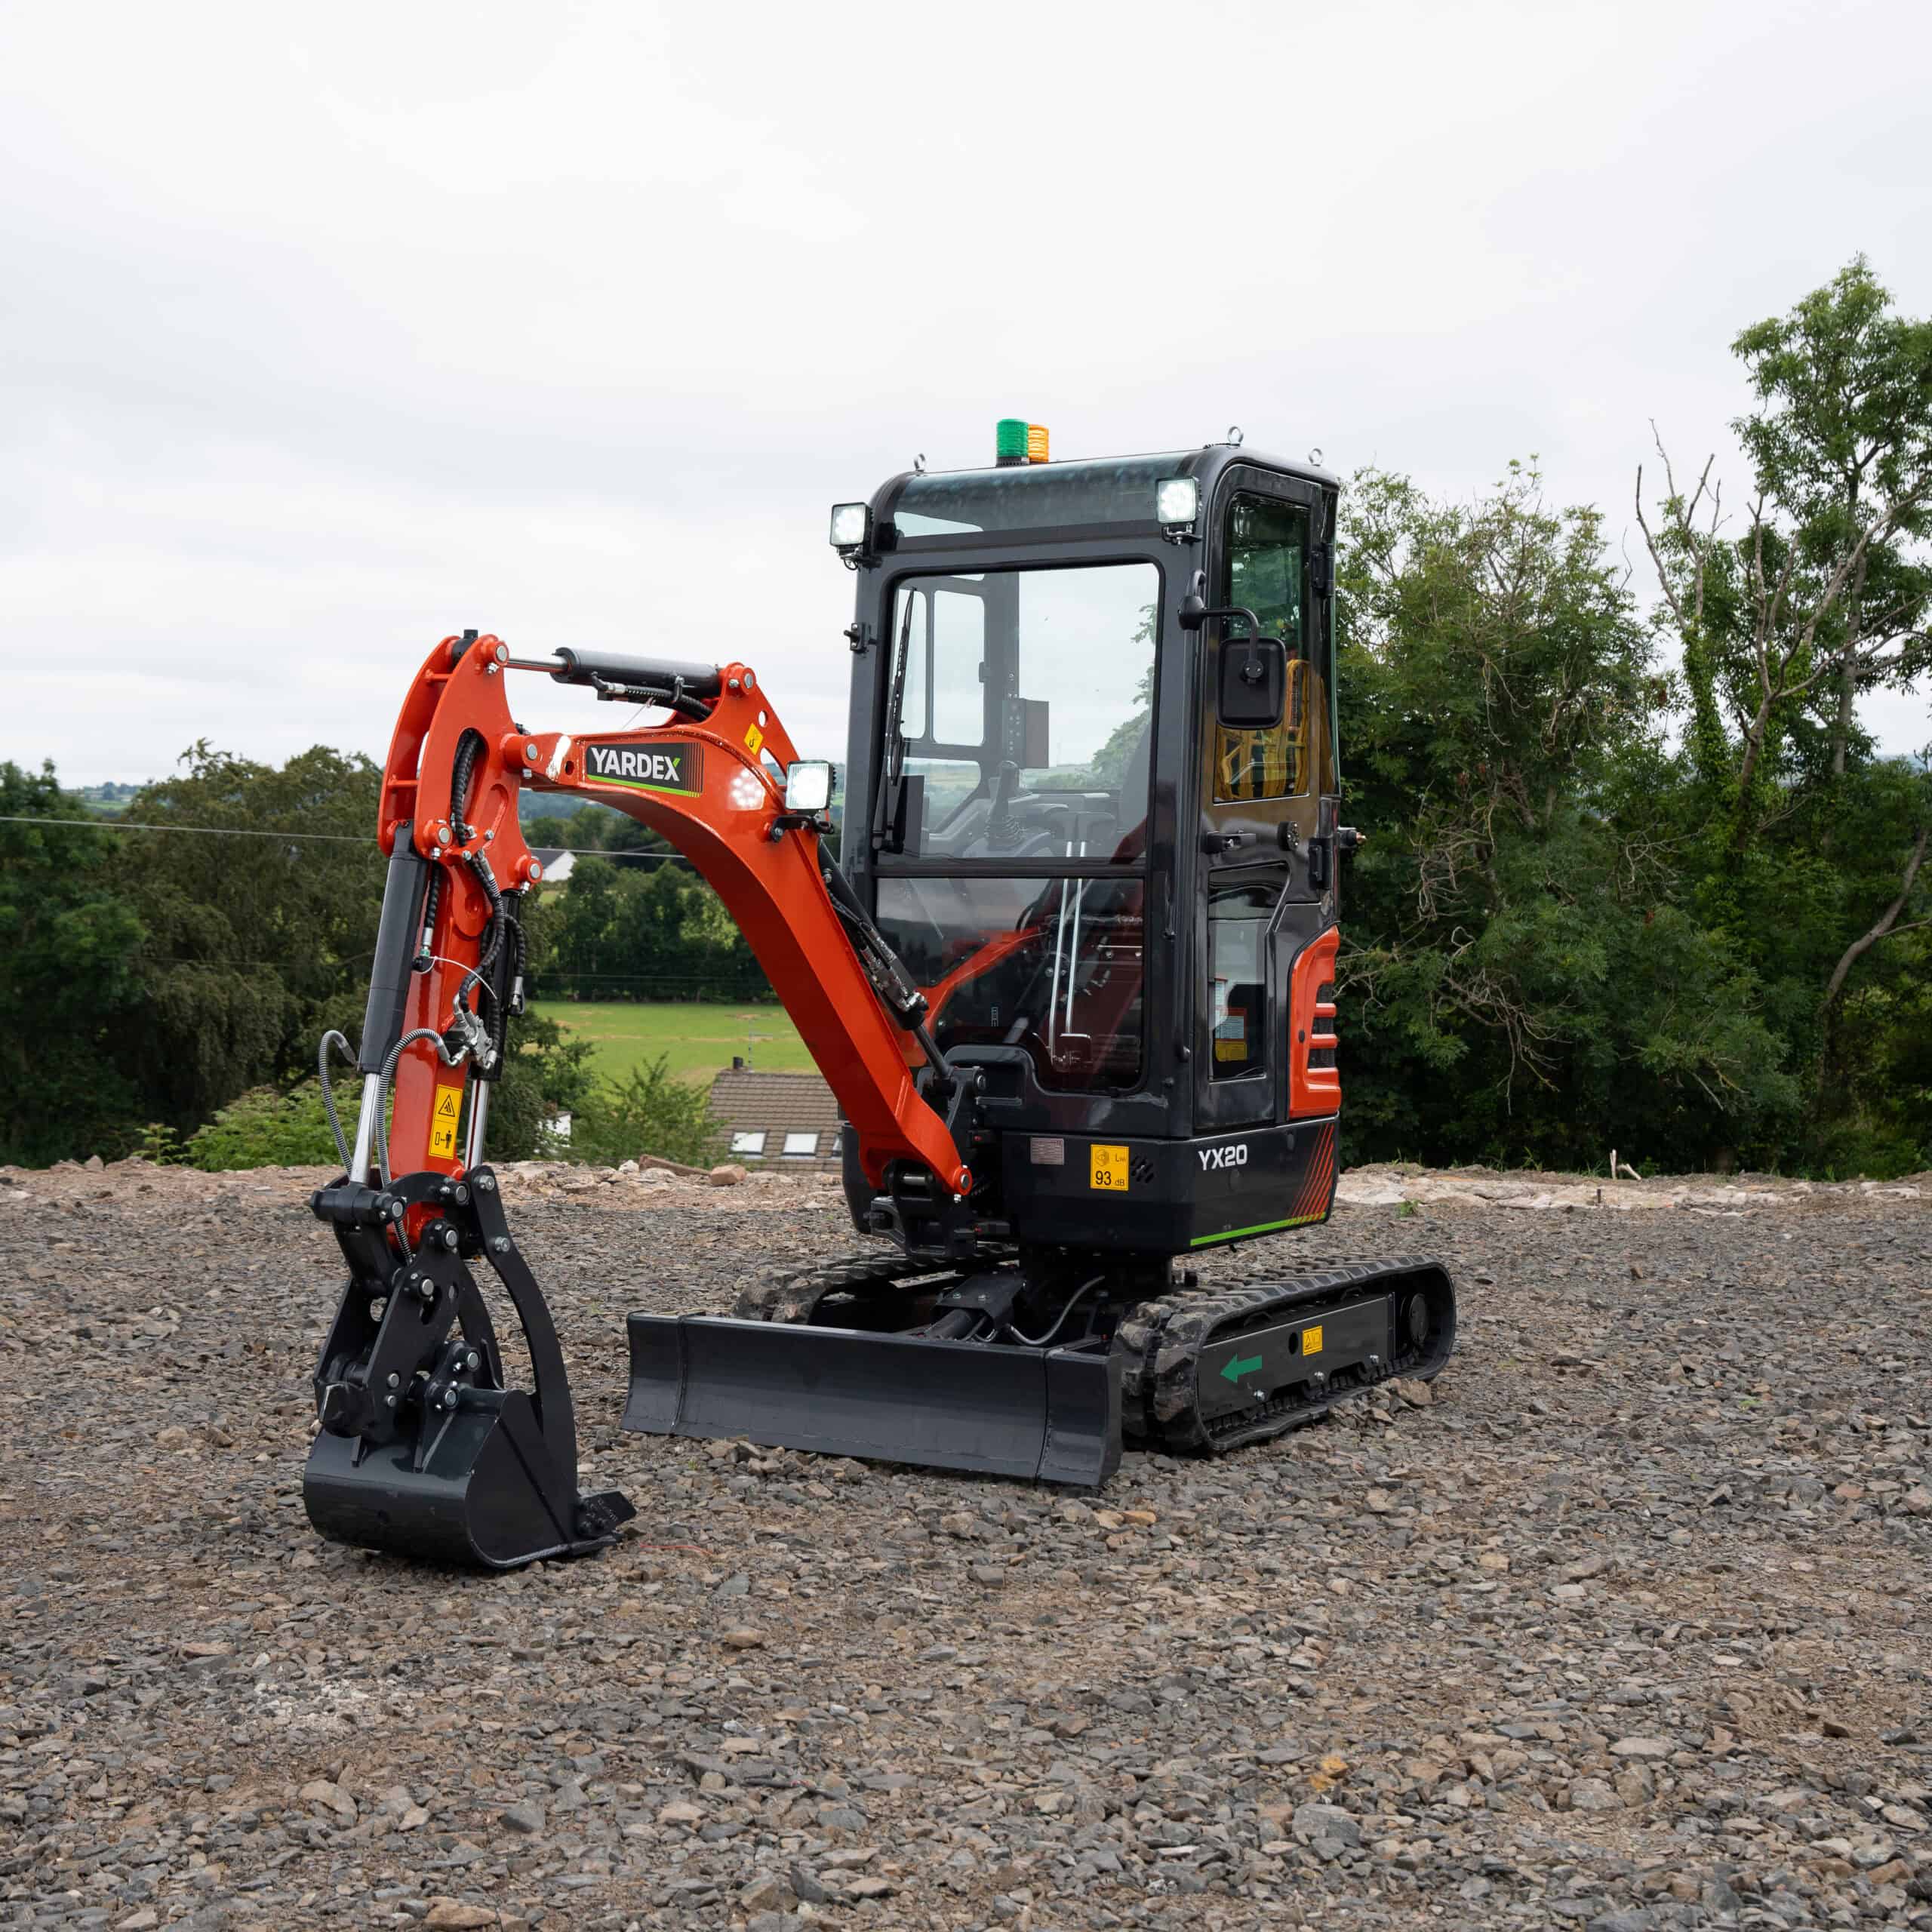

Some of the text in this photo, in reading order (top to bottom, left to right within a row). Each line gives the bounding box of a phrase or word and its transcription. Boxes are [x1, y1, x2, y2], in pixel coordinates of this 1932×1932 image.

[591, 747, 681, 781] YARDEX
[1198, 1143, 1247, 1171] YX20
[1095, 1171, 1125, 1186] 93 dB
